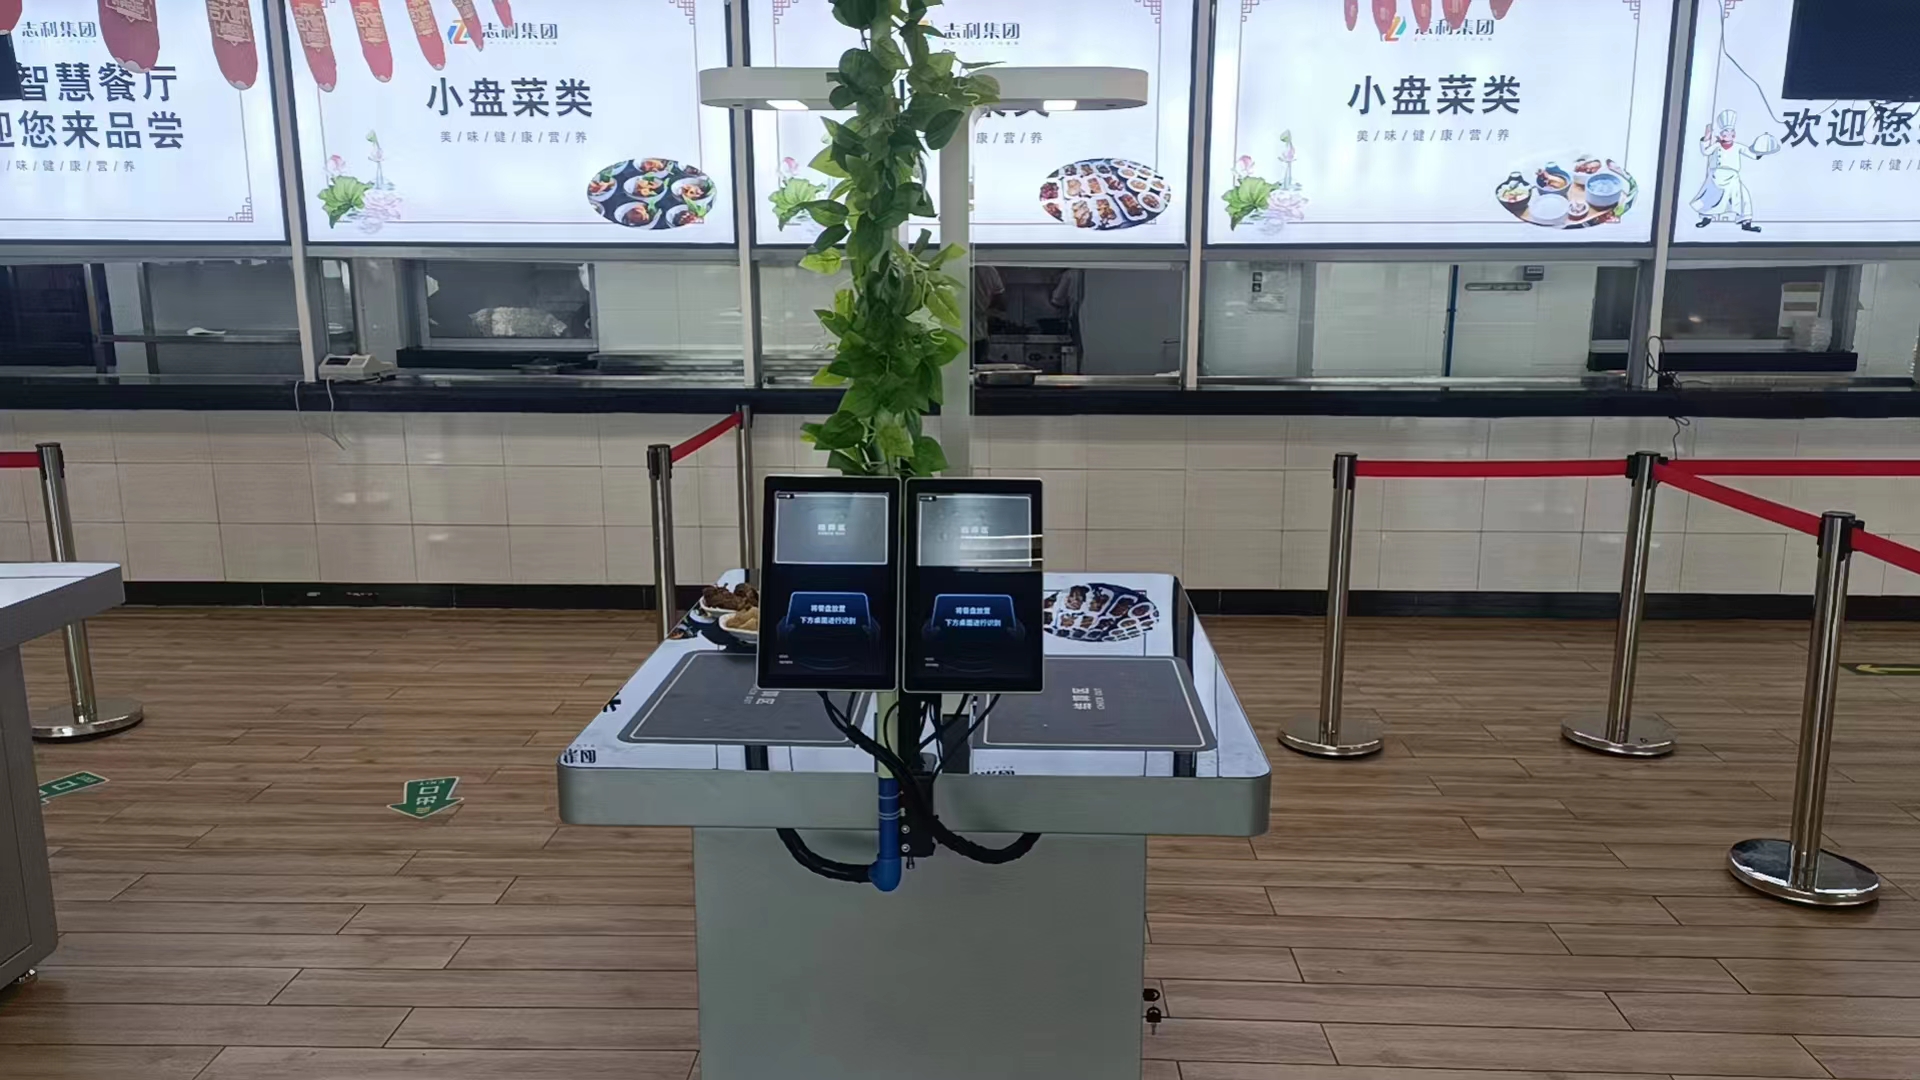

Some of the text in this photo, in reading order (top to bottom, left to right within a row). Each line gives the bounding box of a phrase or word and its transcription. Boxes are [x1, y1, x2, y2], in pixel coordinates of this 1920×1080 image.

[21, 21, 97, 38] 志利集团
[944, 22, 1020, 39] 志利集团
[1414, 19, 1494, 35] 利集团
[16, 62, 177, 102] 智慧餐厅
[426, 77, 592, 117] 小盘菜类
[1347, 74, 1521, 115] 小盘菜类
[1780, 107, 1920, 148] 欢迎您
[416, 785, 440, 806] 出口
